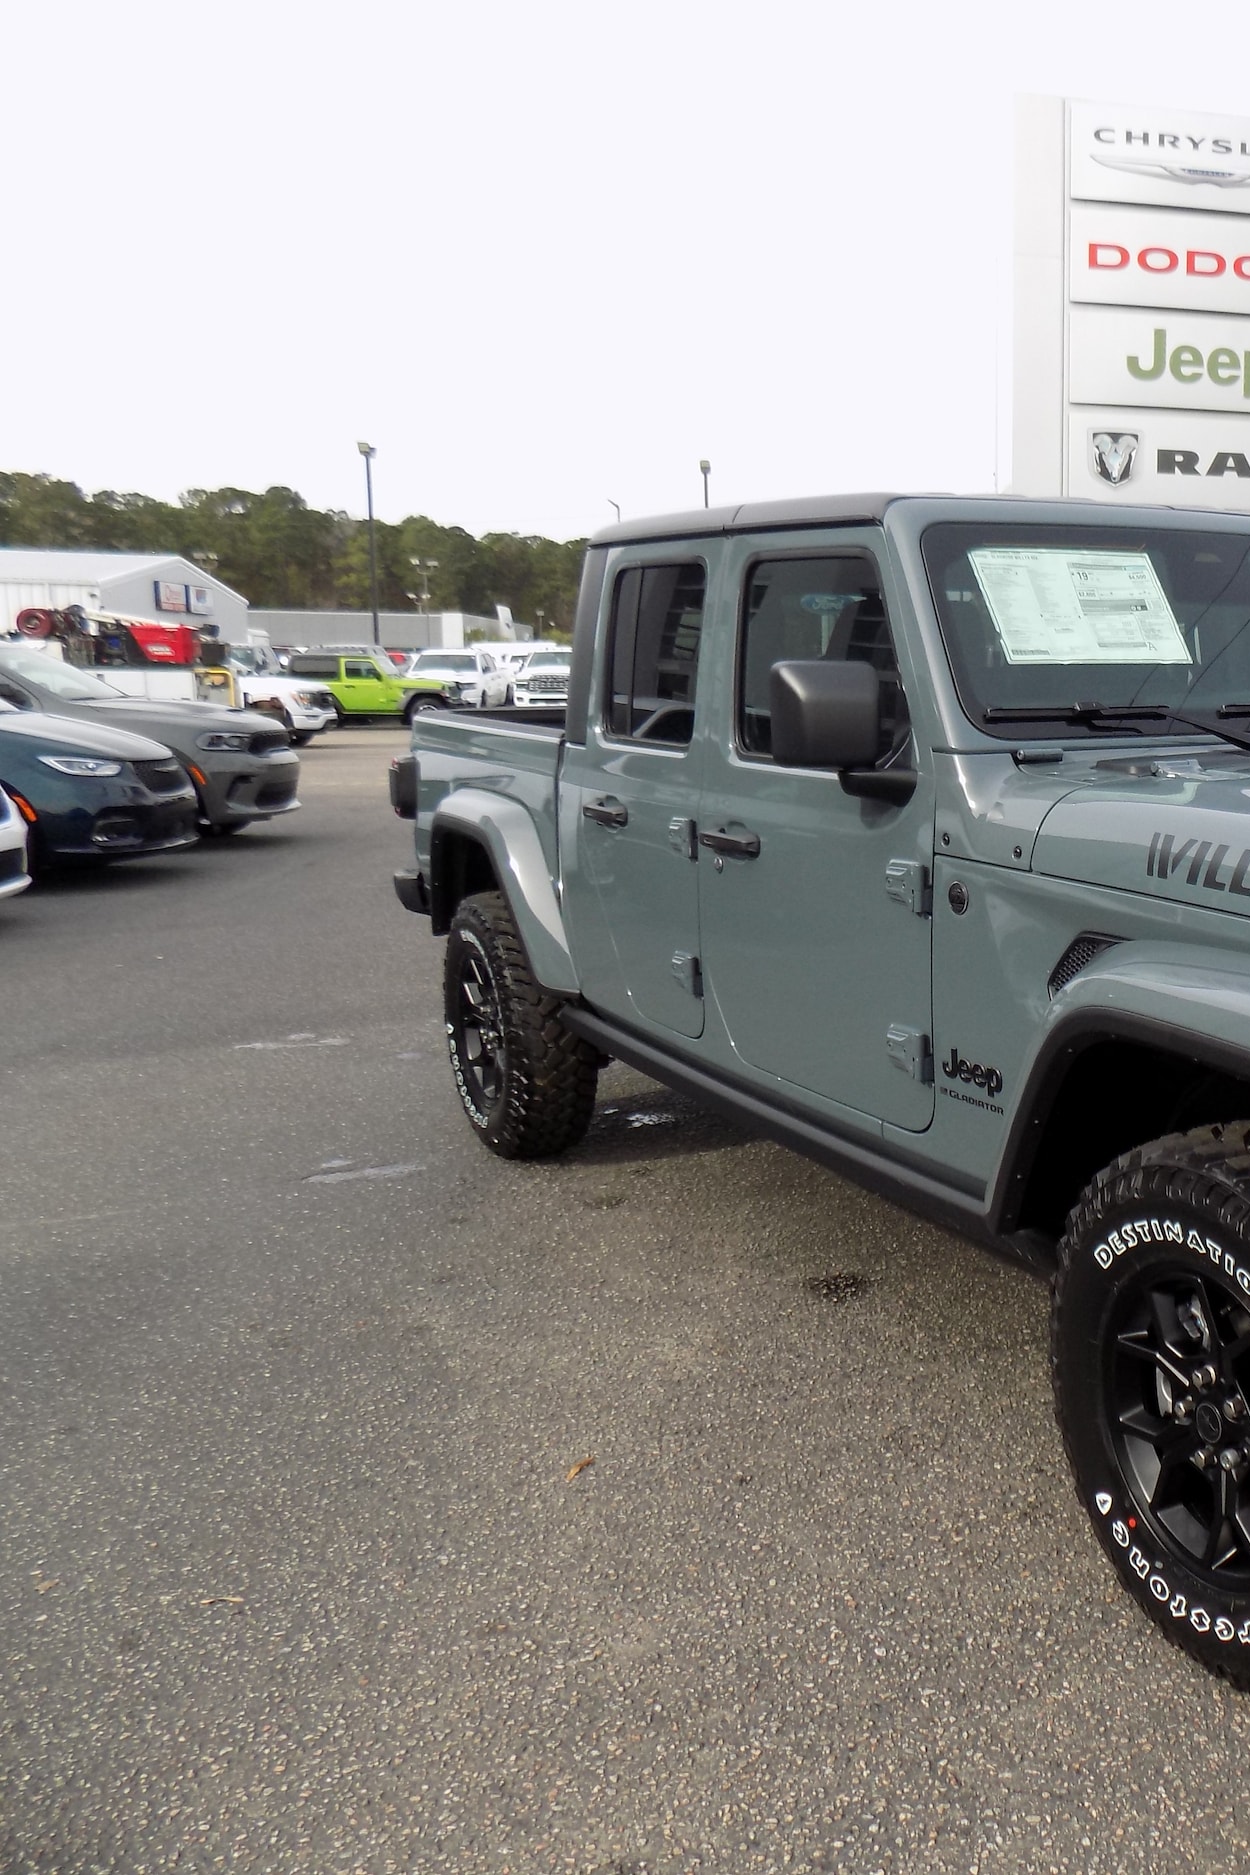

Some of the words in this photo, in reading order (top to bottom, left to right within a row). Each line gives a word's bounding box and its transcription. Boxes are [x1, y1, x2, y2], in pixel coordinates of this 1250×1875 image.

[1077, 571, 1089, 581] 19
[942, 1047, 1003, 1098] Jeep
[949, 1089, 1005, 1116] GLADIATOR
